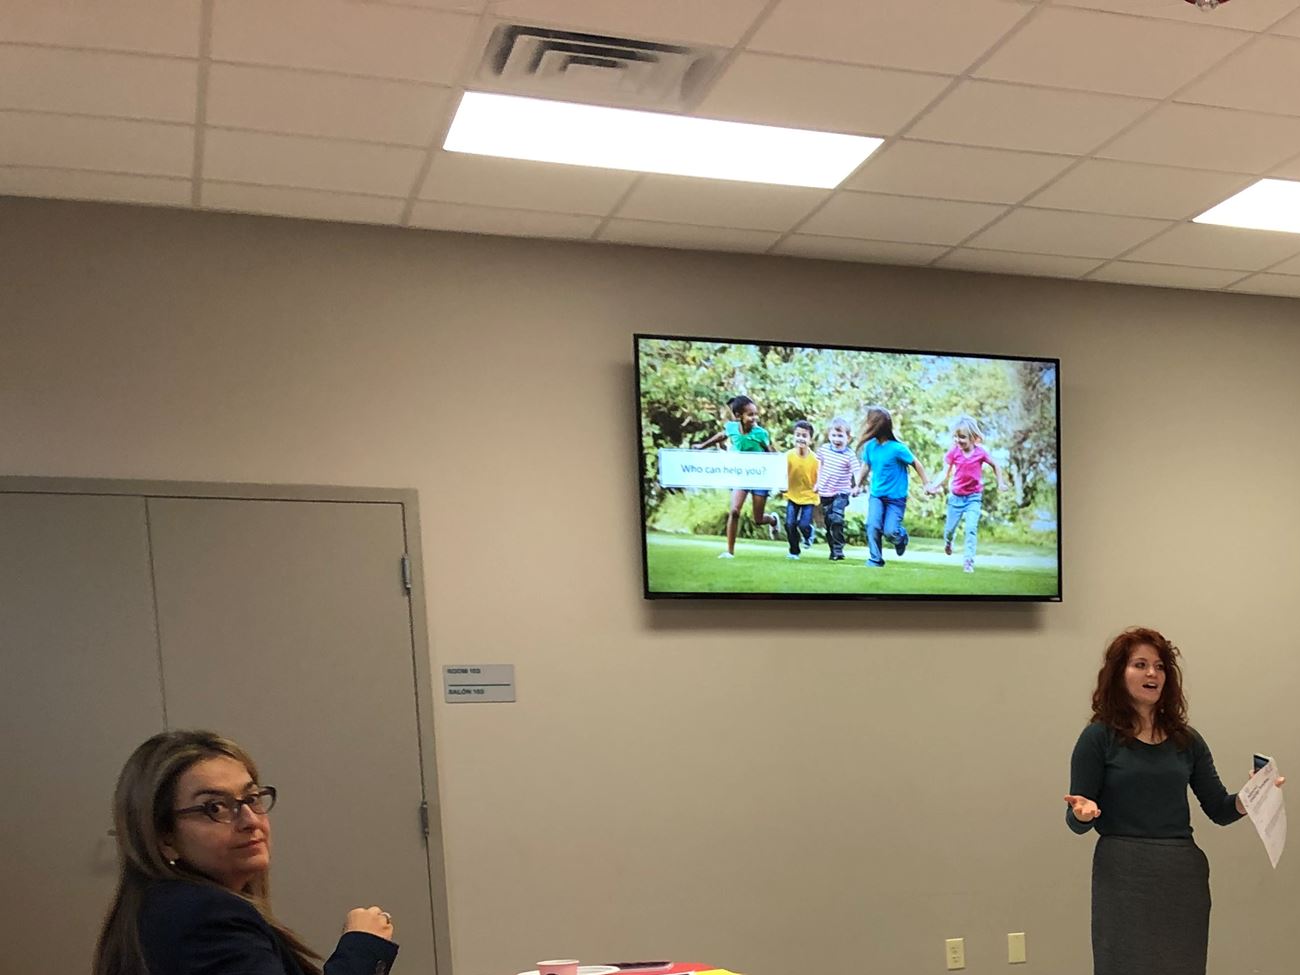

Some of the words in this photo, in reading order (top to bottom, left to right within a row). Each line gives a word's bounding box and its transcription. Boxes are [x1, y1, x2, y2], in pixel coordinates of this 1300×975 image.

[681, 464, 703, 473] Who
[723, 464, 743, 475] help
[745, 466, 767, 476] you?
